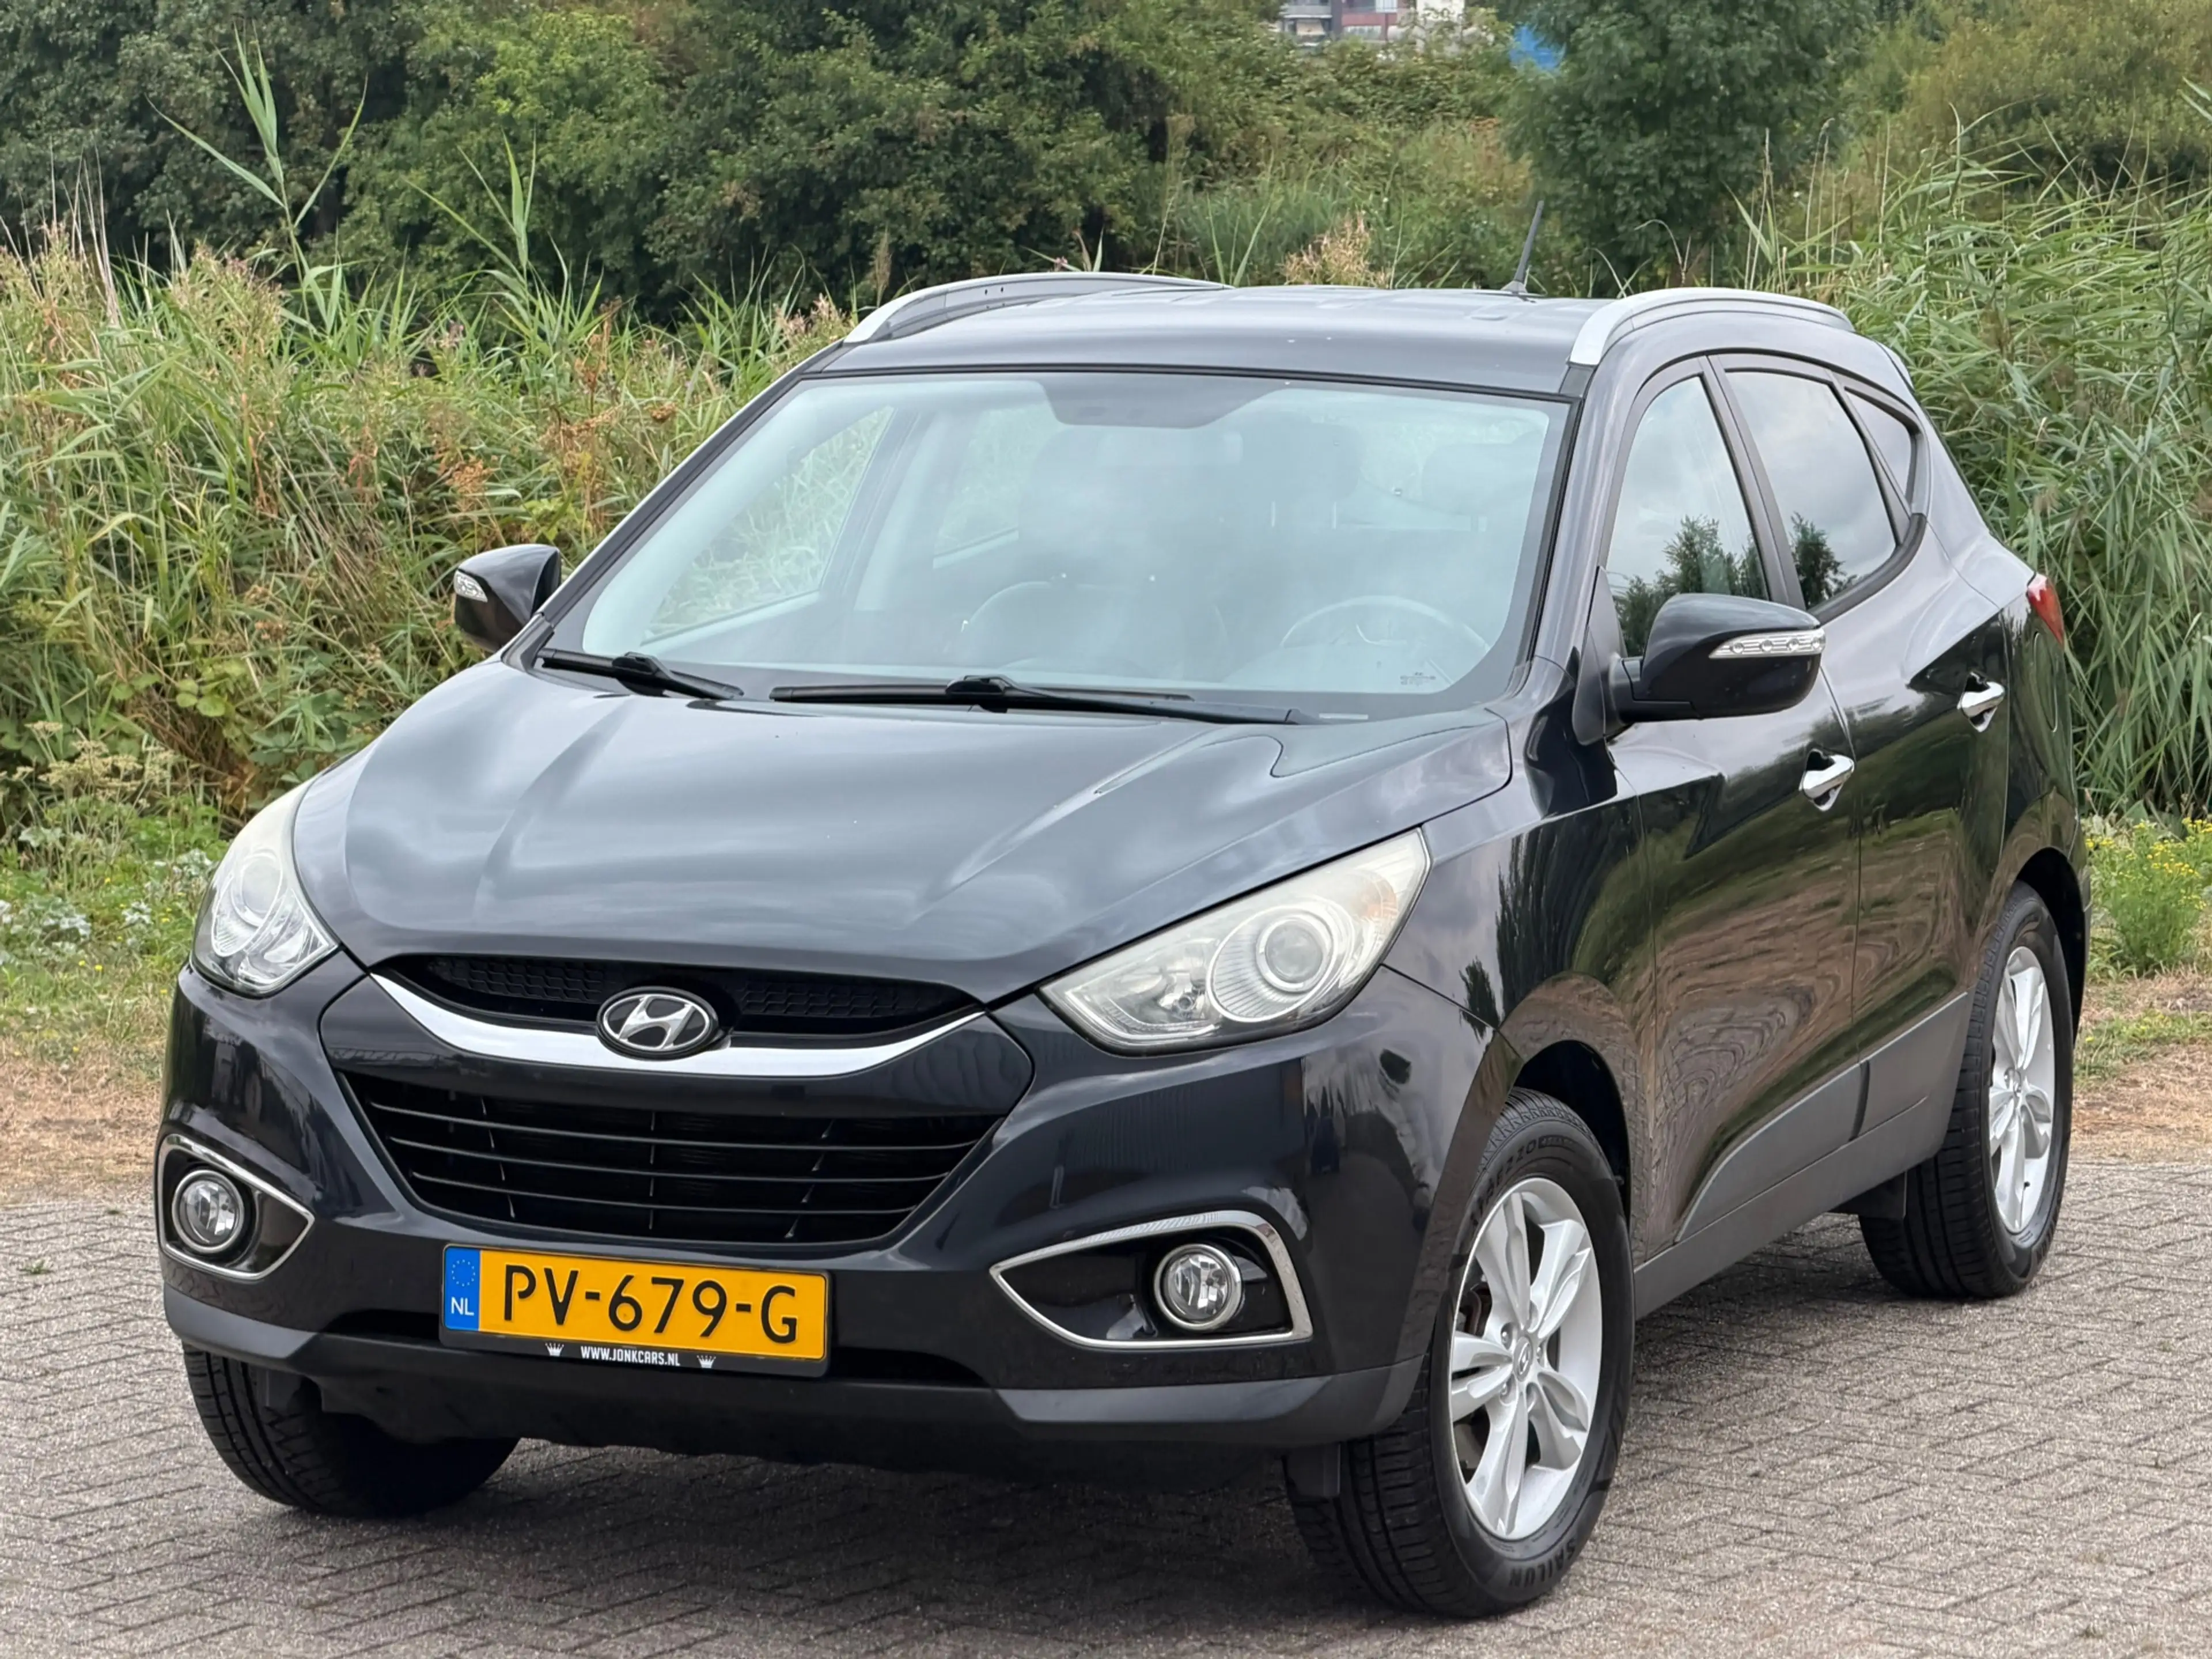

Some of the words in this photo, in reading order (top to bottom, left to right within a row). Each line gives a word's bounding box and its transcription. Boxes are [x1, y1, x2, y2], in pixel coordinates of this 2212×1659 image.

[451, 1296, 475, 1316] NL
[503, 1264, 798, 1344] PV-679-G
[580, 1346, 680, 1367] WWW.JONKCARS.NL
[1509, 1537, 1575, 1588] SAILUN
